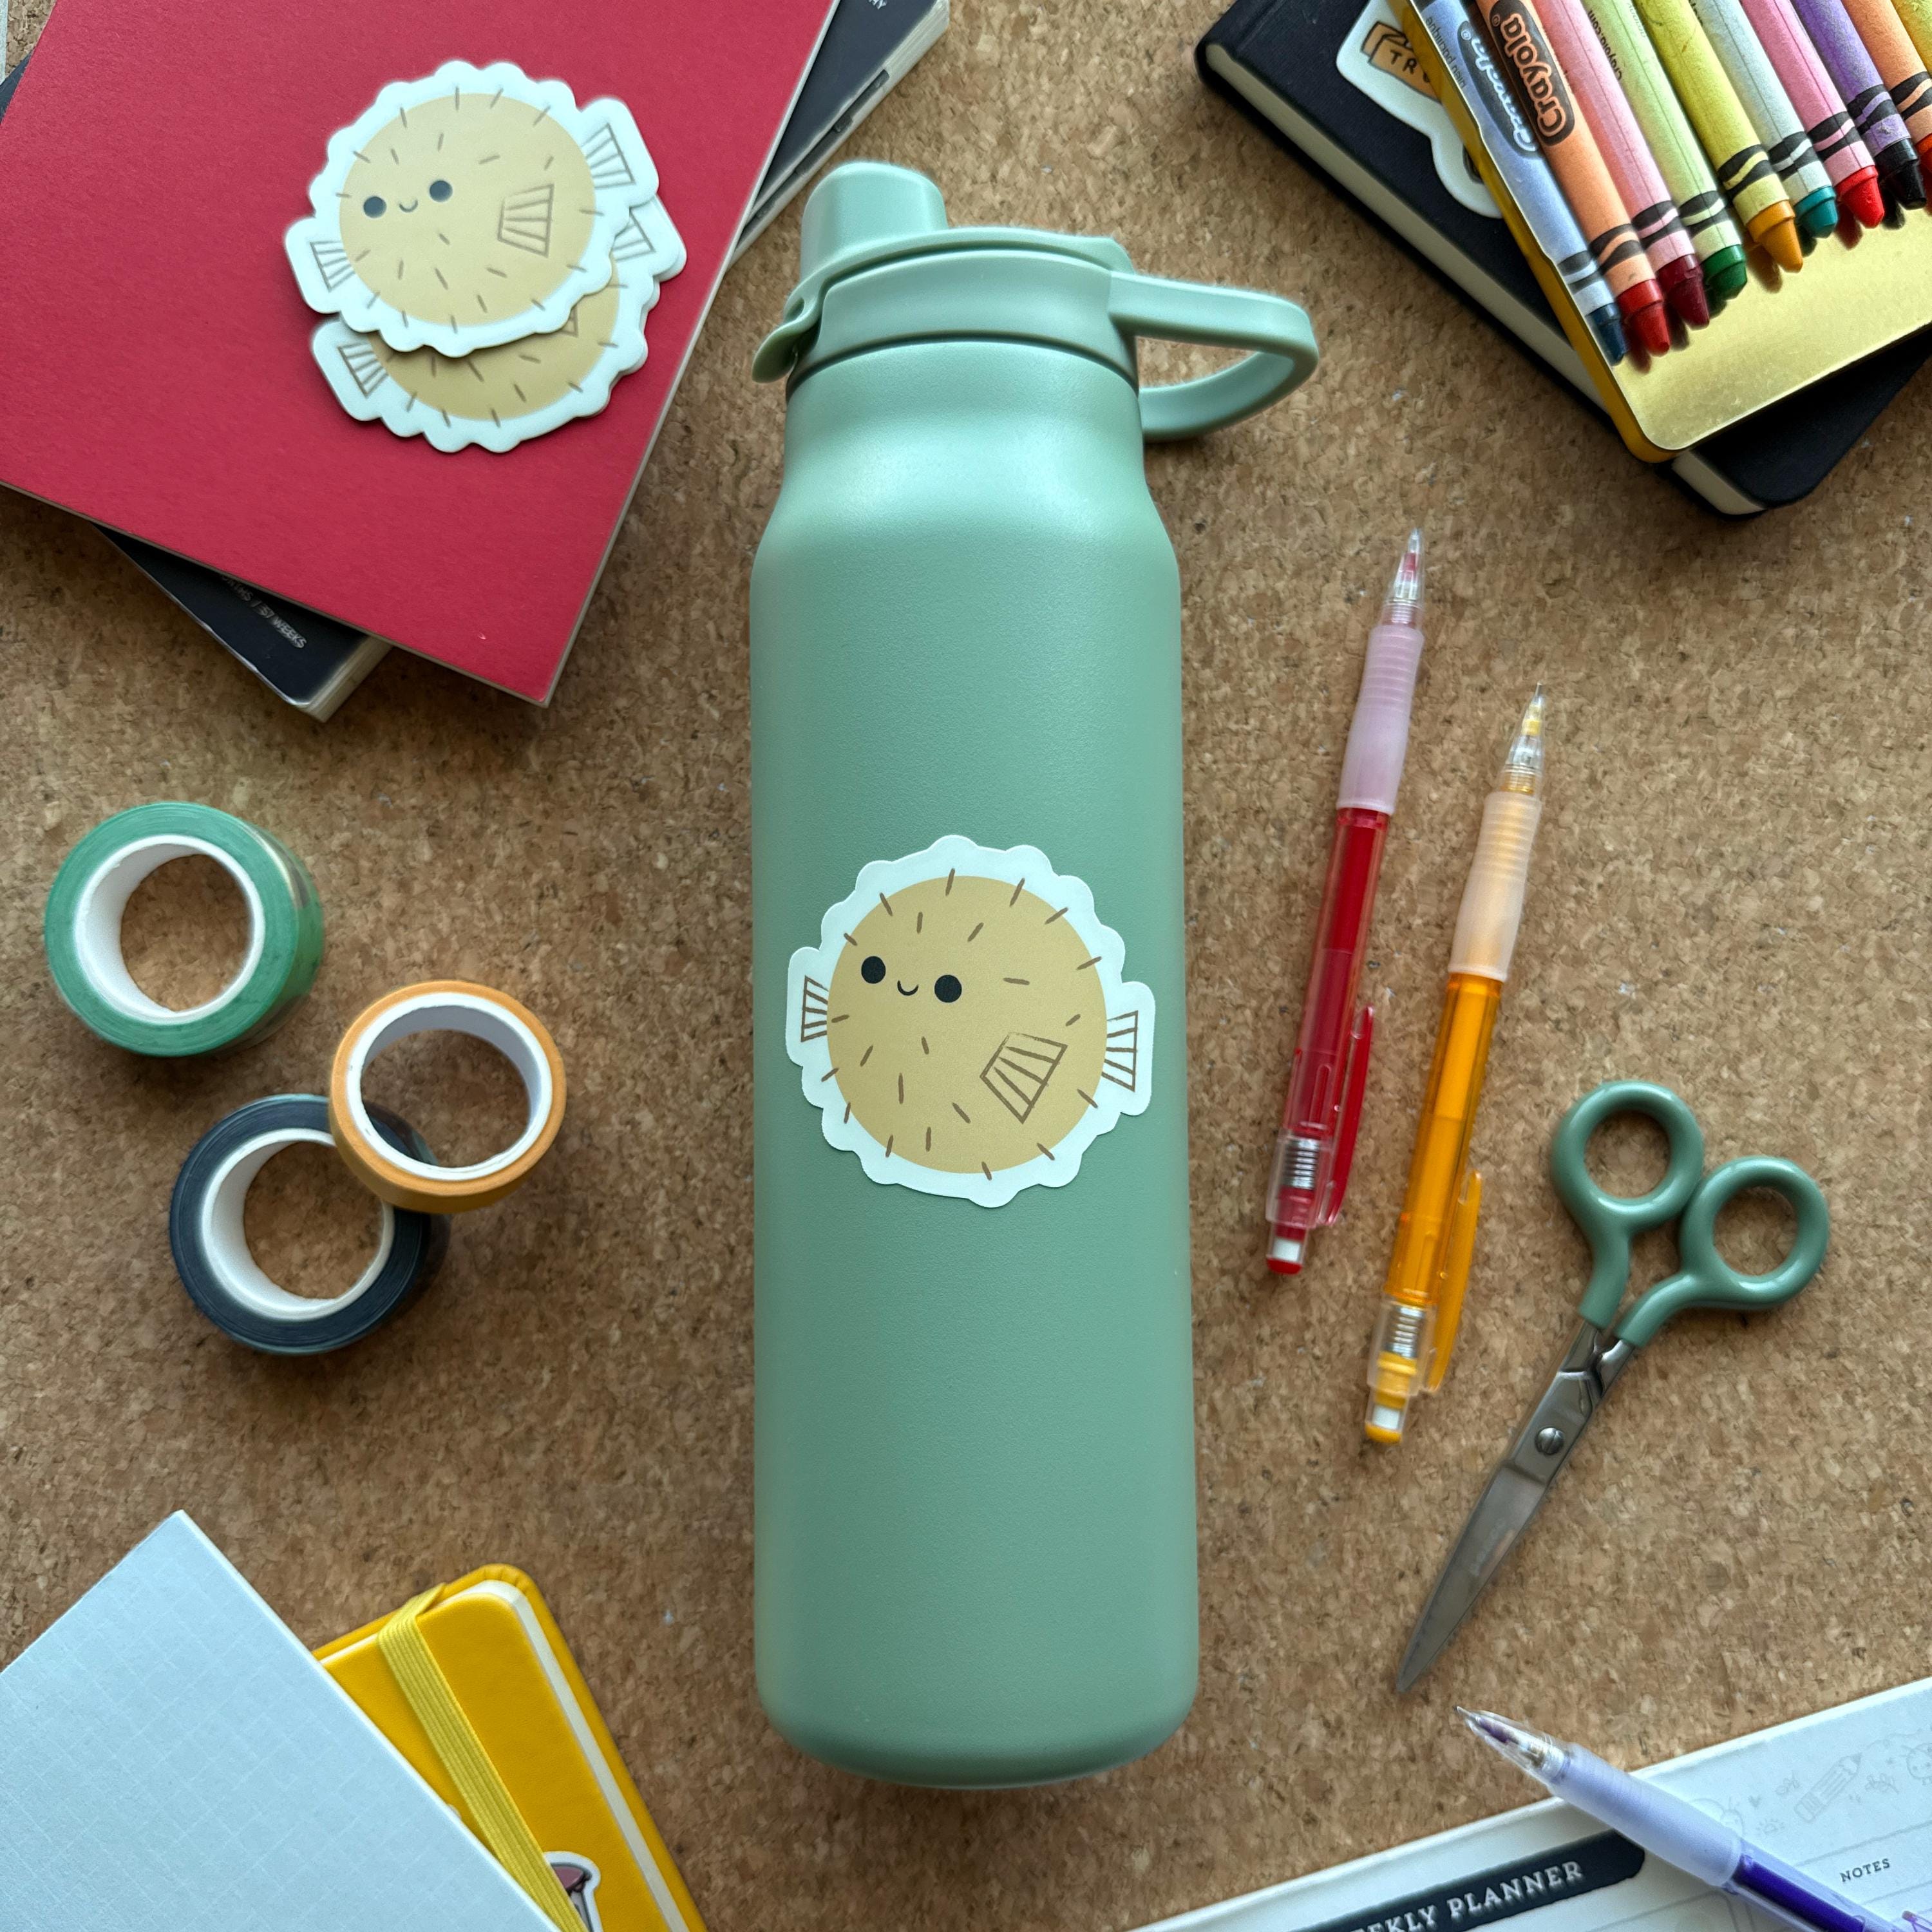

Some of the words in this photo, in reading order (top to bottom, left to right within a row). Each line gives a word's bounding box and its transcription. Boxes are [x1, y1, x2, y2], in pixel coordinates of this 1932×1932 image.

[273, 616, 307, 648] WEEKS
[1839, 1858, 1891, 1882] NOTES
[1446, 1861, 1585, 1923] PLANNER
